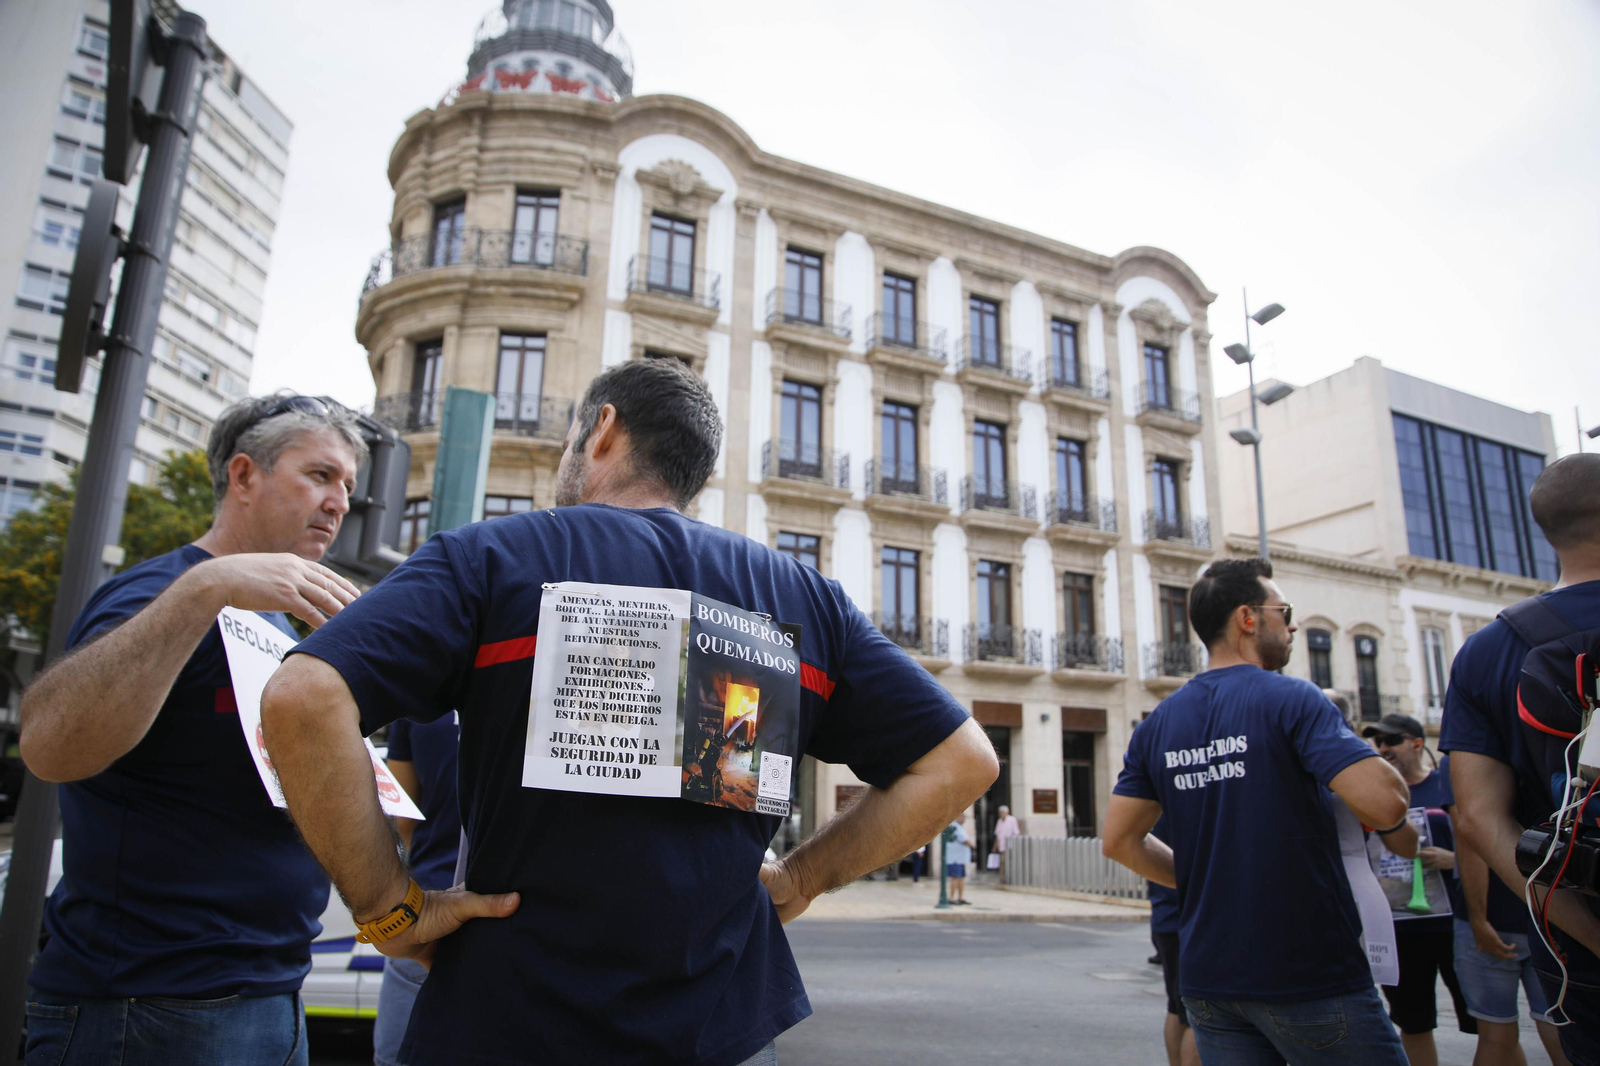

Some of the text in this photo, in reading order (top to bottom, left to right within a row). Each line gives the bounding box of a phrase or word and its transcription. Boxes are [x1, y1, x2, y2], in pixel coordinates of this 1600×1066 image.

[560, 595, 671, 612] AMENAZAS, MENTIRAS,
[555, 604, 675, 621] BOICOT... LA RESPUESTA
[561, 615, 580, 624] DEL
[582, 617, 659, 630] AYUNTAMIENTO
[697, 602, 794, 649] BOMBEROS
[588, 626, 640, 638] NUESTRAS
[564, 634, 661, 650] REIVINDICACIONES.
[567, 654, 656, 670] HAN CANCELADO
[696, 632, 796, 675] QUEMADOS
[570, 666, 650, 681] FORMACIONES,
[564, 677, 654, 692] EXHIBICIONES...
[556, 687, 661, 704] MIENTEN DICIENDO
[553, 698, 662, 715] QUE LOS BOMBEROS
[555, 709, 658, 726] ESTÁN EN HUELGA.
[549, 731, 660, 750] JUEGAN CON LA
[550, 747, 657, 765] SEGURIDAD DE
[1164, 735, 1248, 769] BOMEROS
[564, 763, 641, 780] LA CIUDAD
